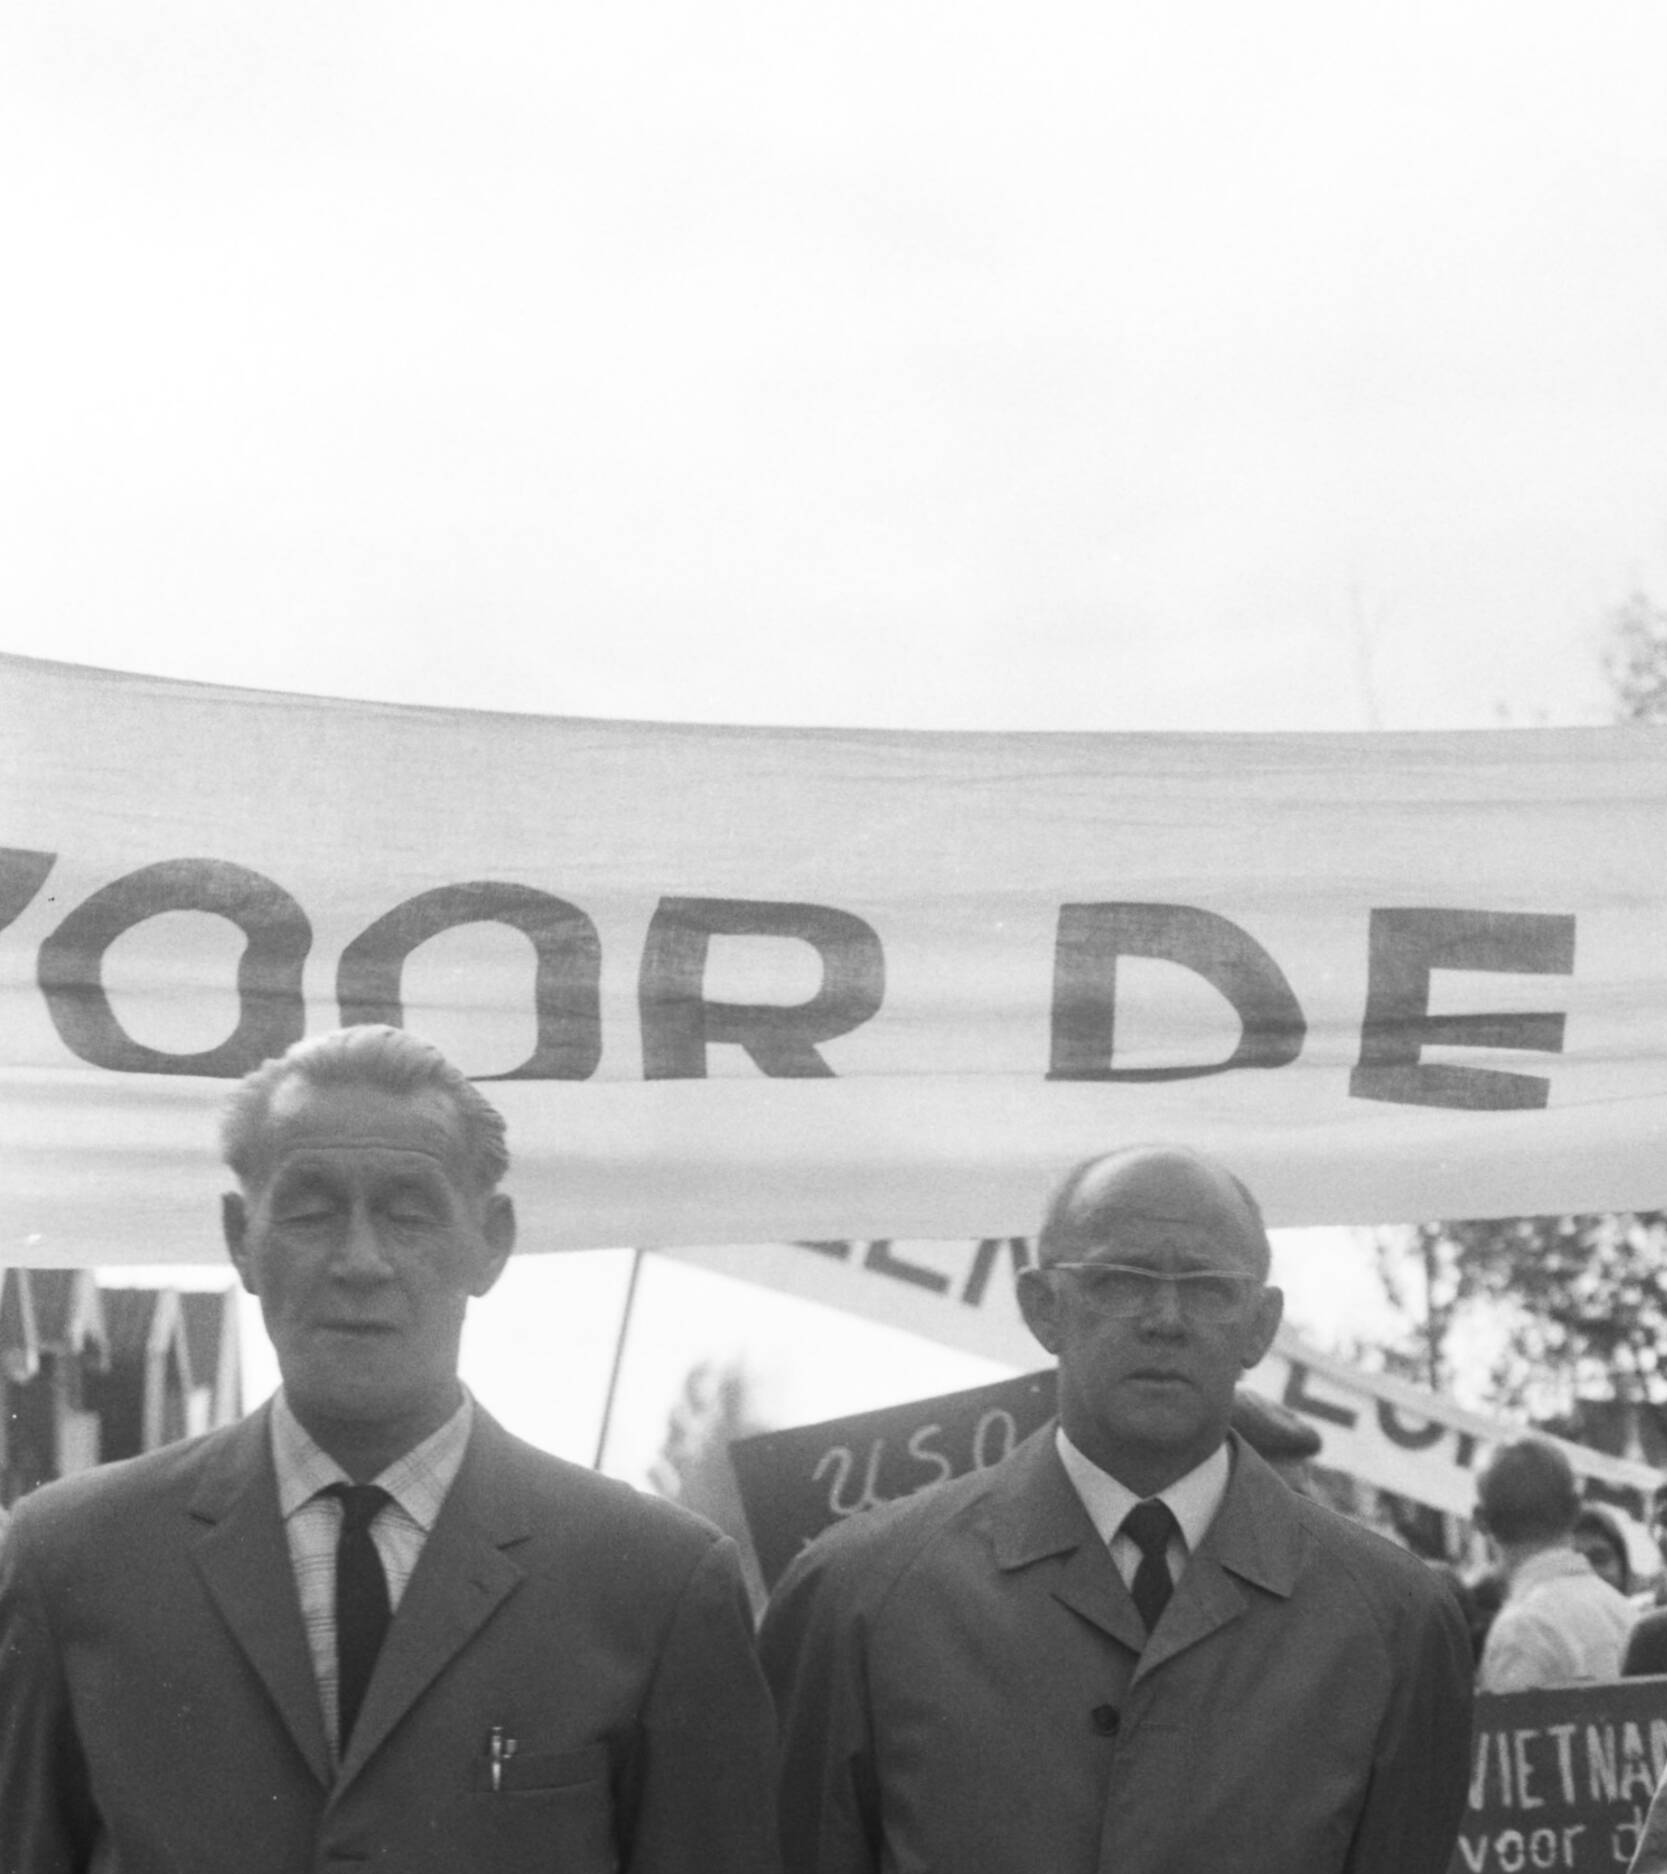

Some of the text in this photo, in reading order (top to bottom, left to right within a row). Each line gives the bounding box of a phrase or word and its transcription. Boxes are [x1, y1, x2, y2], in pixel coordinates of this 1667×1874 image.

[0, 848, 887, 1080] OOR
[1045, 901, 1578, 1111] DE
[1457, 1828, 1587, 1874] voor
